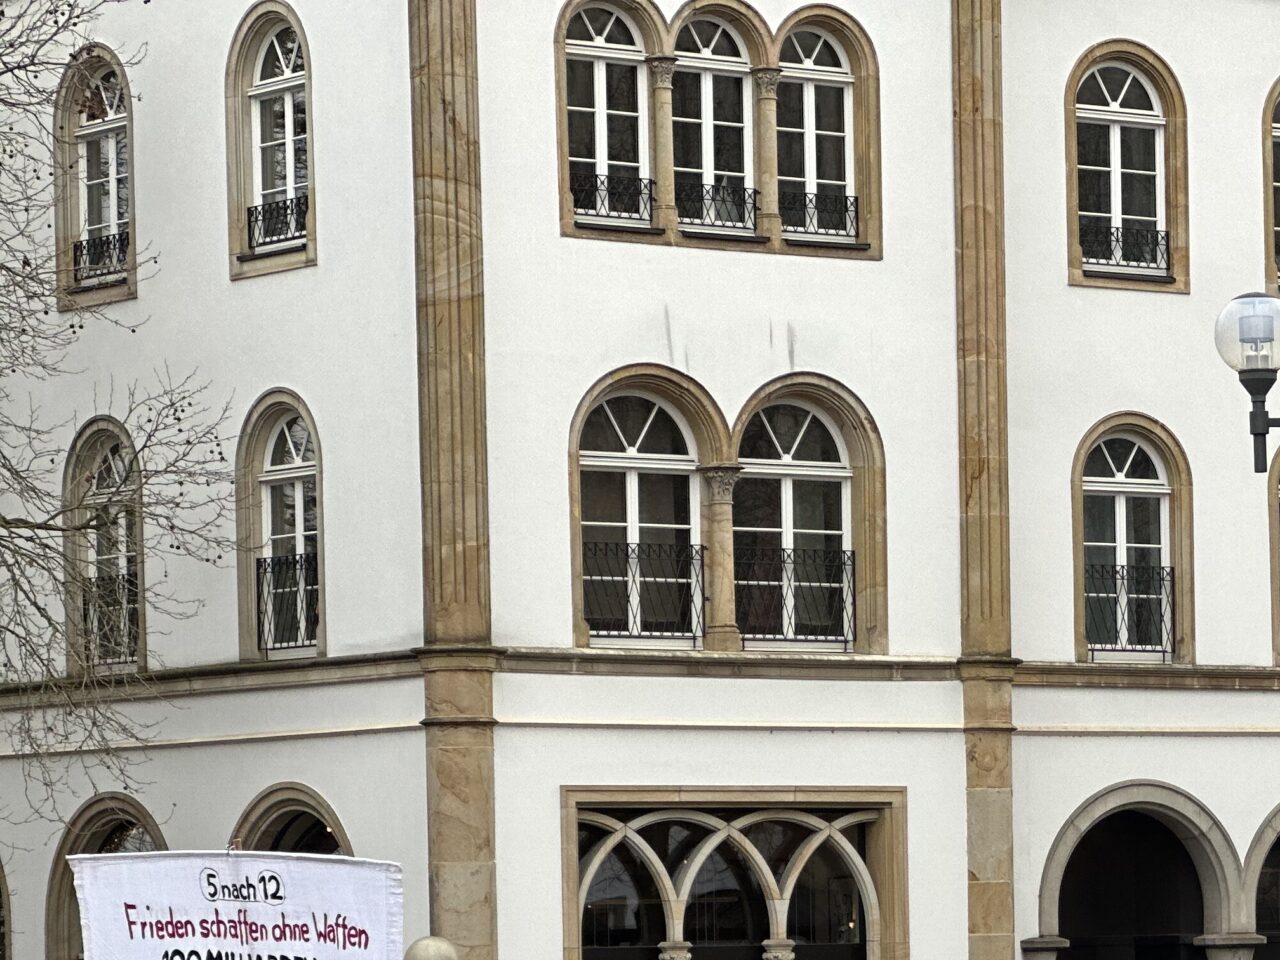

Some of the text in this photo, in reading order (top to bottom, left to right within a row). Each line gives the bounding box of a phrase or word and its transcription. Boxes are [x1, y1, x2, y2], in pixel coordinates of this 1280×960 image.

[206, 873, 282, 900] 5 nach 12
[124, 902, 369, 950] Frieden schaffen ohne Waffen
